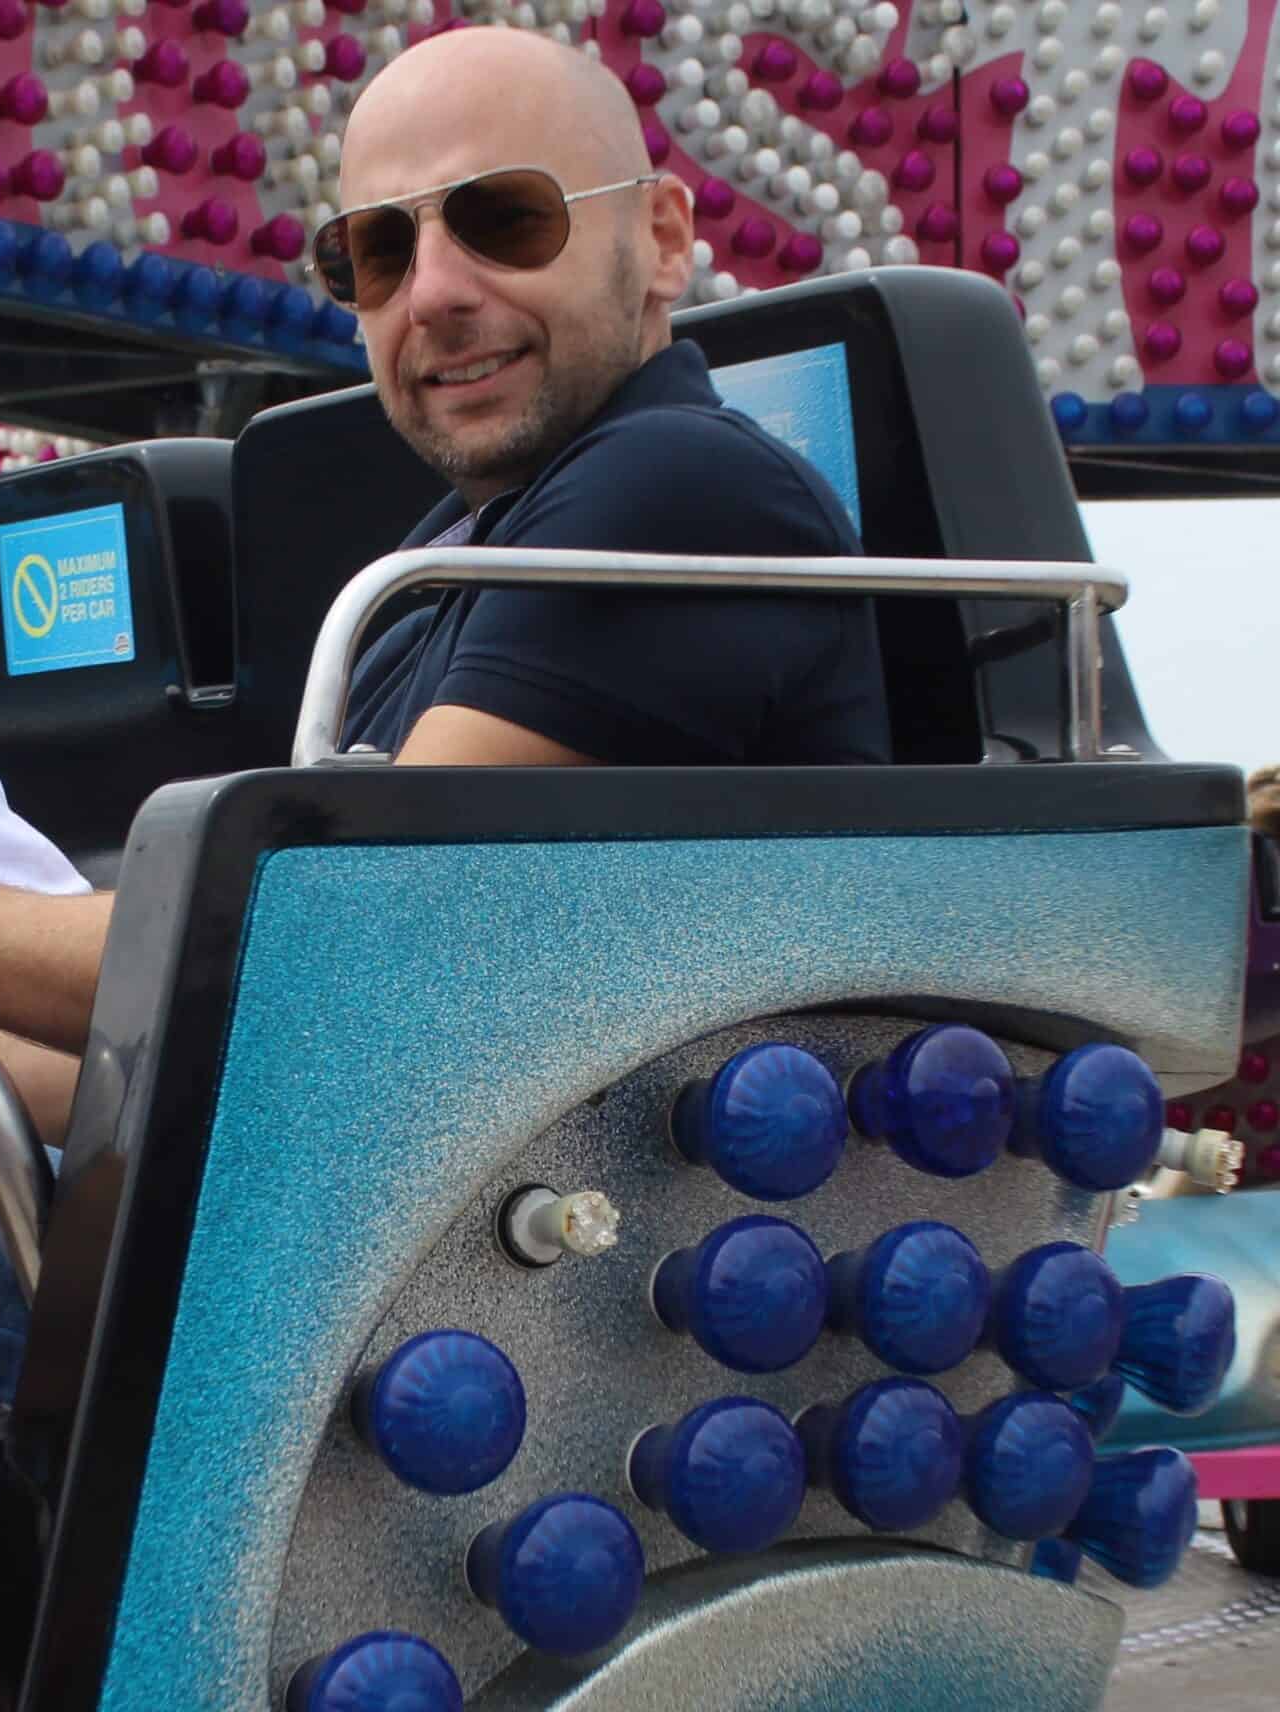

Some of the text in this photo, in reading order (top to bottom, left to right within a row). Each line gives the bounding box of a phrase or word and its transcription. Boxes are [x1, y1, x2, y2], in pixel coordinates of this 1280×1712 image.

[57, 551, 116, 576] MAXIMUM
[59, 575, 114, 600] 2 RIDERS
[62, 599, 115, 624] PER CAR
